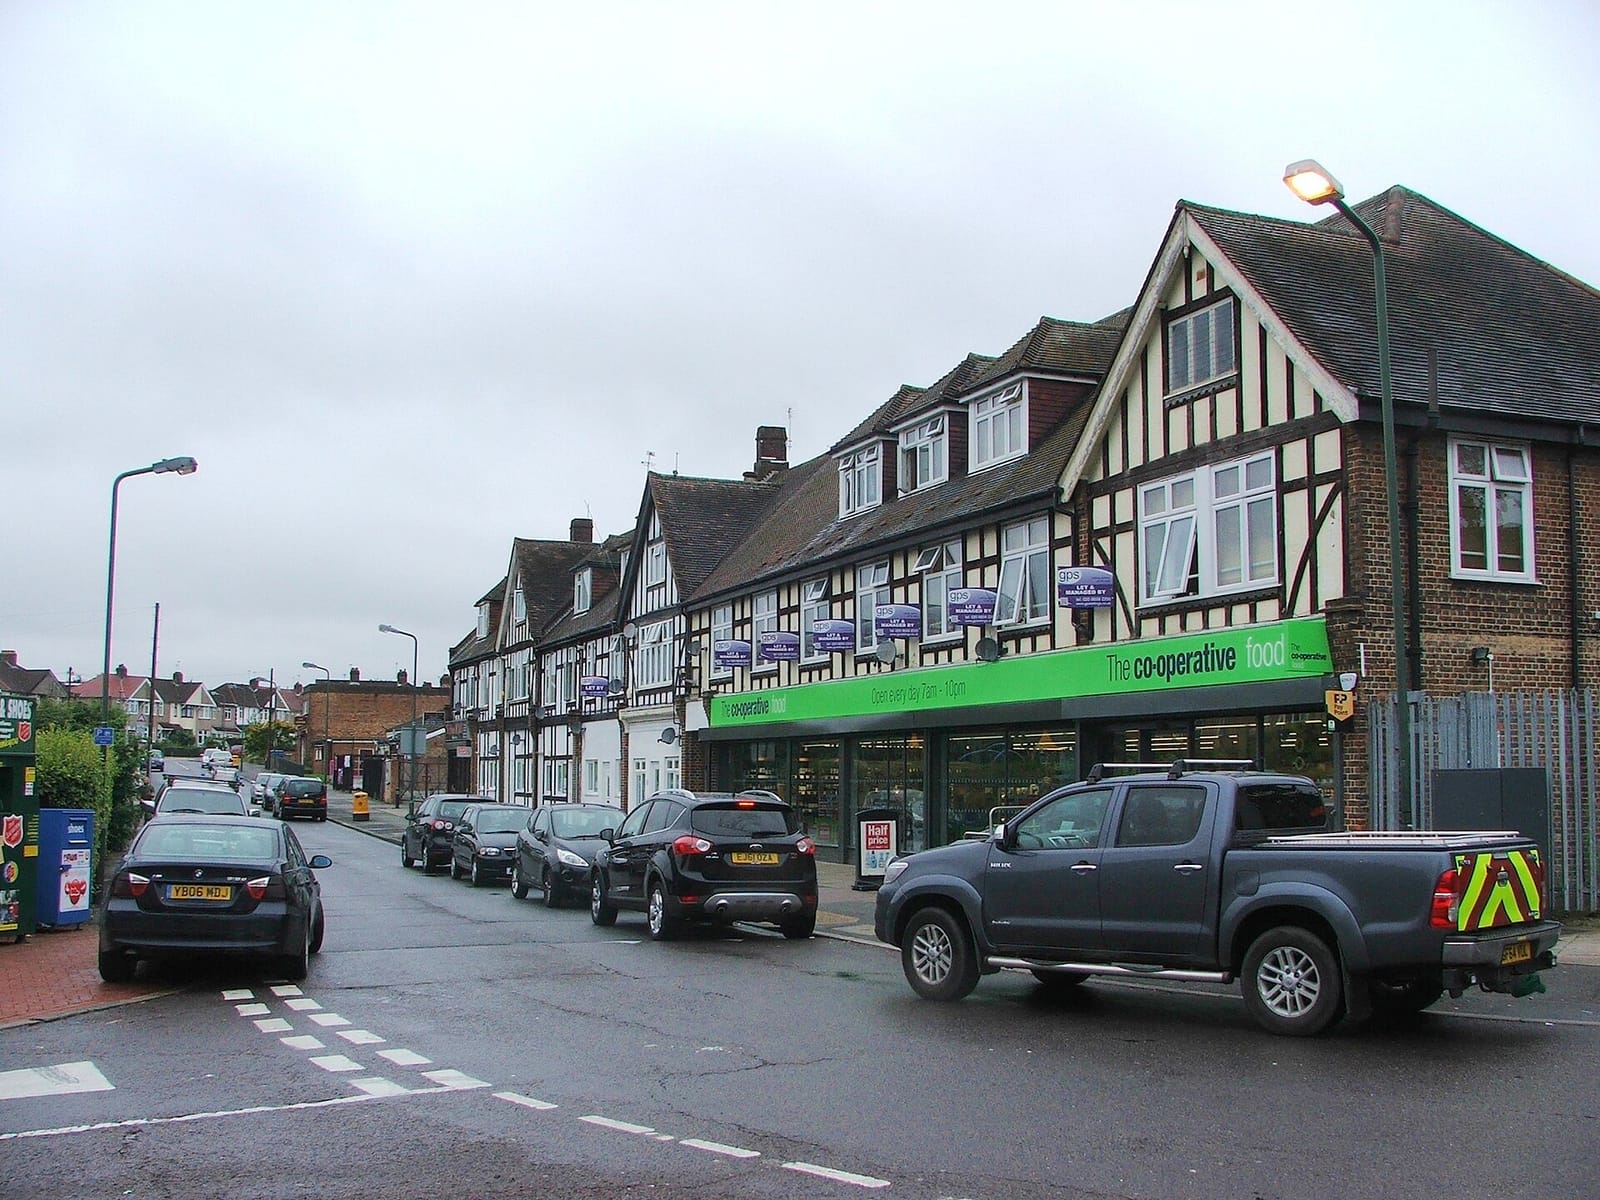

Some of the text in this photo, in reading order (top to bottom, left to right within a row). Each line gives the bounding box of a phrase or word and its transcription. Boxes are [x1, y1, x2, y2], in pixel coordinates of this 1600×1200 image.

[1059, 571, 1080, 582] gps
[950, 591, 968, 602] gps
[876, 607, 894, 618] gps
[814, 623, 830, 632] gps
[1290, 643, 1300, 651] The
[1106, 634, 1285, 682] The co-operative food
[872, 688, 888, 706] Open
[889, 689, 907, 705] every
[908, 685, 920, 704] day
[922, 682, 937, 699] 7am
[945, 680, 966, 700] 10pm
[7, 699, 33, 719] SHOES
[721, 694, 787, 720] The co-operative food
[868, 825, 888, 835] Half
[868, 836, 888, 846] price
[174, 887, 203, 897] YB06
